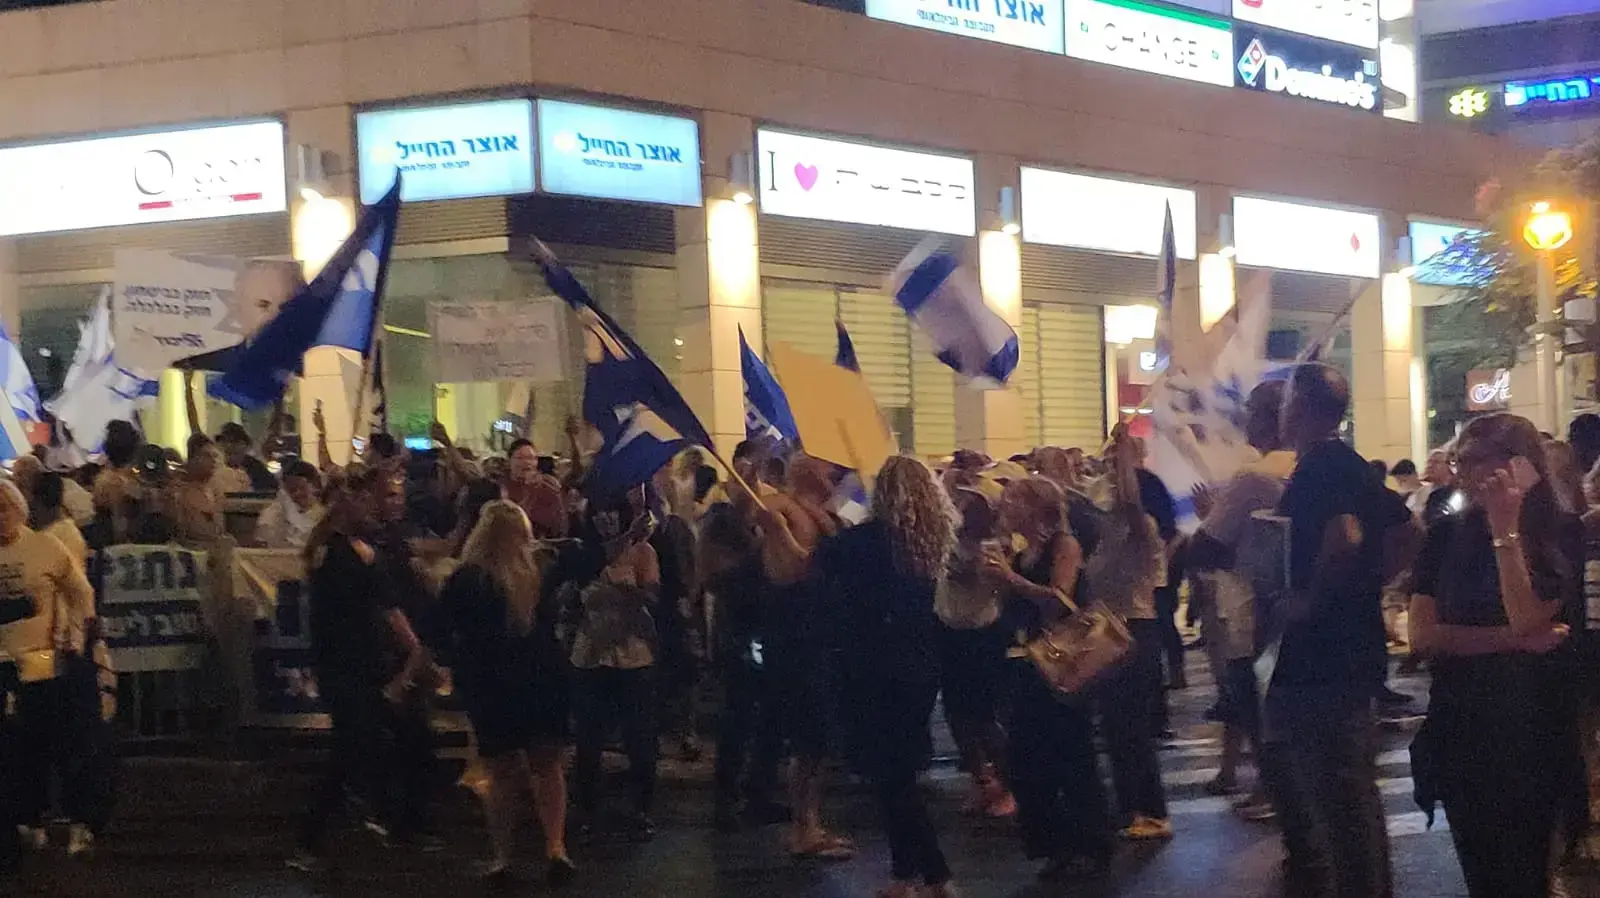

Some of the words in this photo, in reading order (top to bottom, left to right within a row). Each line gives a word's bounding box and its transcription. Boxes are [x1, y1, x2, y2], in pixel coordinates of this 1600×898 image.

[395, 139, 457, 159] החייל
[461, 133, 520, 154] אוצר
[577, 132, 632, 158] החייל
[635, 142, 683, 163] אוצר
